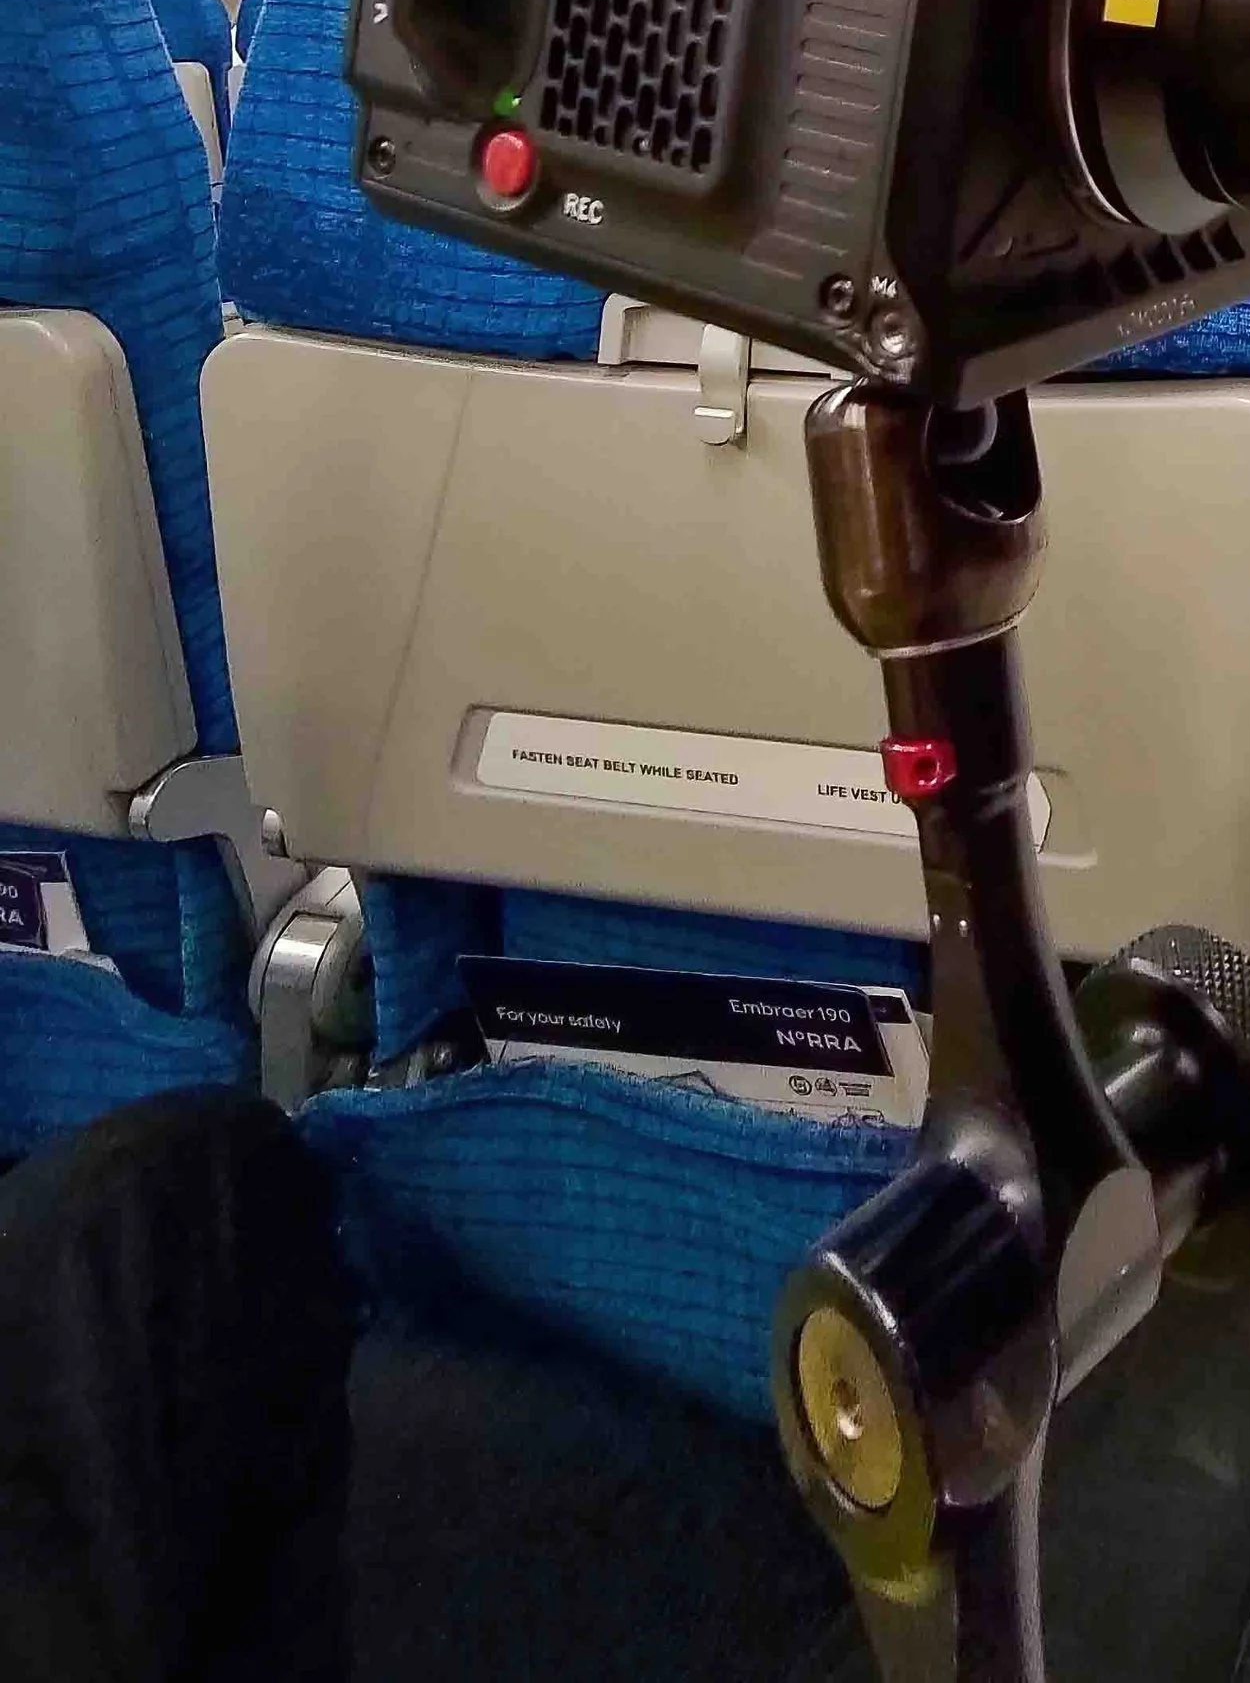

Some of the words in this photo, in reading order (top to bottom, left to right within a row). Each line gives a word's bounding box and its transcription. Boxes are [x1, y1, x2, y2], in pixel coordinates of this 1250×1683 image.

[563, 192, 604, 225] REC
[512, 748, 562, 766] FASTEN
[566, 754, 599, 770] SEAT
[603, 758, 636, 774] BELT
[640, 763, 682, 779] WHILE
[686, 768, 739, 786] SEATED
[817, 783, 847, 798] LIFE
[851, 787, 887, 803] VEST
[496, 1006, 524, 1022] For
[527, 1012, 564, 1026] your
[729, 998, 814, 1019] Embraer
[816, 1006, 851, 1024] 190
